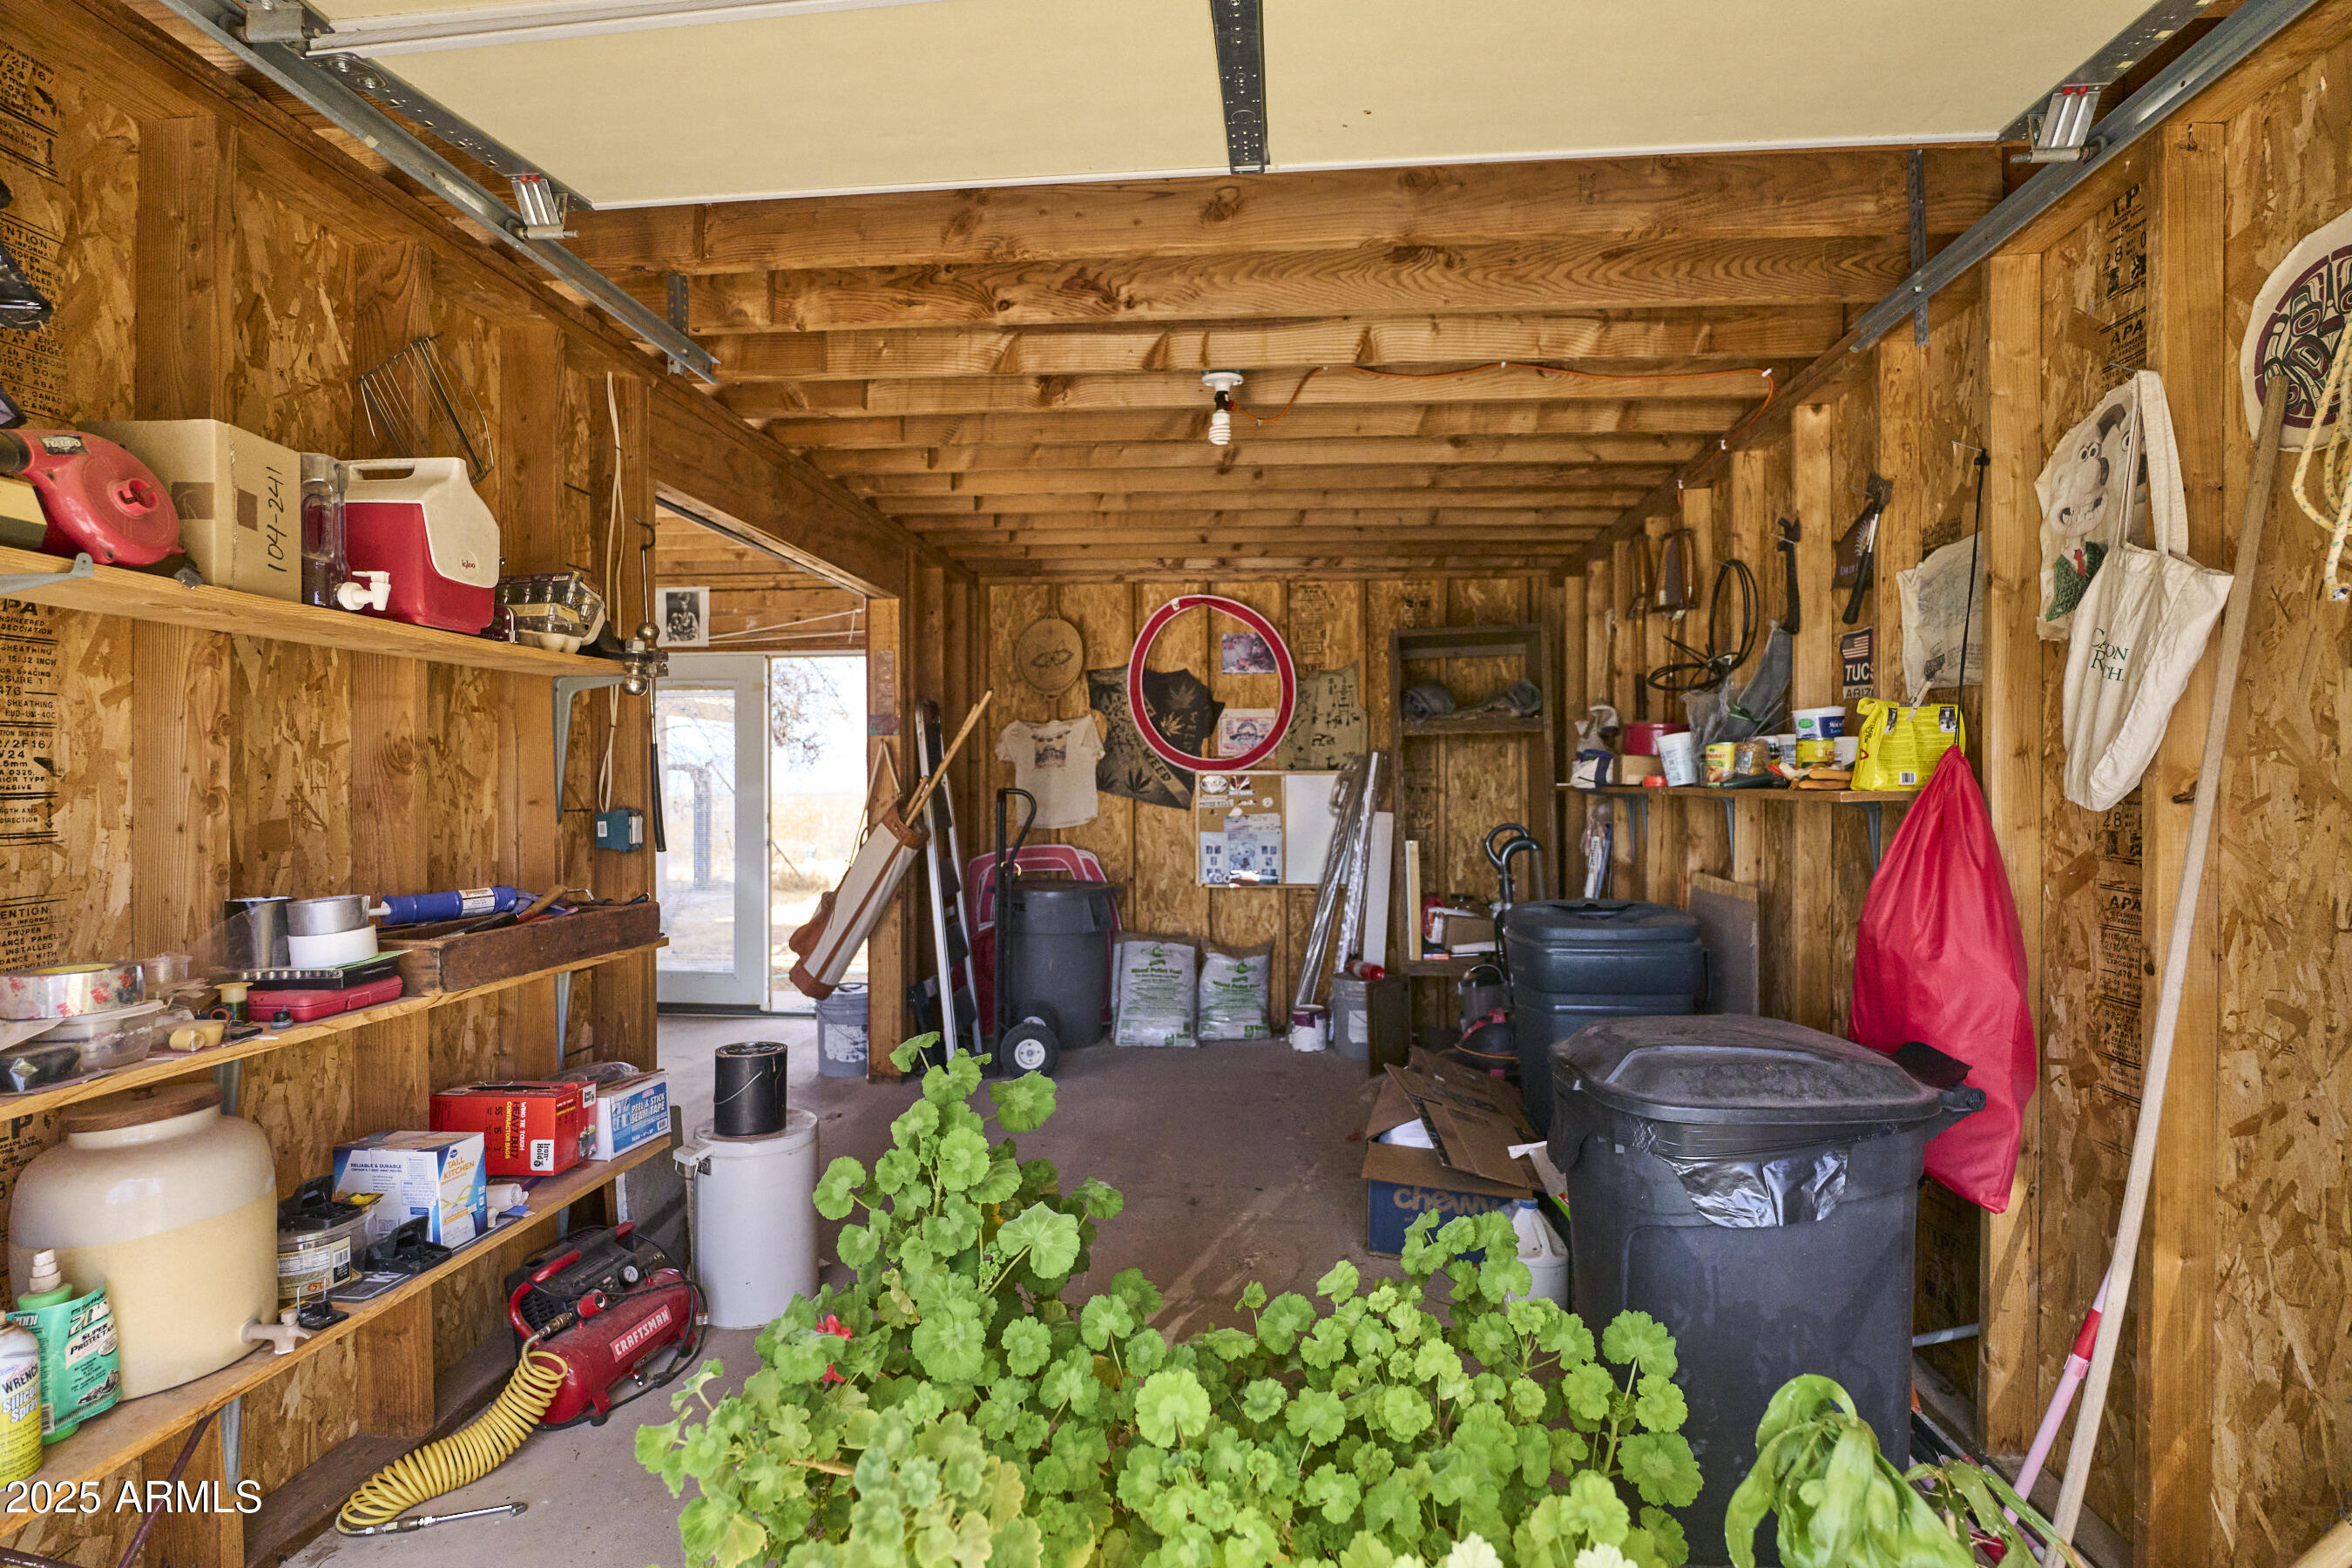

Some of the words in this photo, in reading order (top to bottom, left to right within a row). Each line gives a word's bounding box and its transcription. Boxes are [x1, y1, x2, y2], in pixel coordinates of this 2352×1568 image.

[2111, 319, 2143, 347] APA
[266, 466, 287, 572] 104-241
[461, 559, 476, 570] igloo
[1, 645, 52, 656] SHEATHING
[2091, 627, 2129, 661] CAON
[37, 658, 57, 666] INCH
[2091, 649, 2125, 682] RCH.
[7, 699, 53, 709] SHEATHING
[2110, 896, 2142, 912] APA
[5, 943, 53, 956] INSTALLED
[36, 950, 57, 960] WITH
[631, 1108, 649, 1125] SEAM
[650, 1101, 666, 1116] TAPE
[632, 1101, 644, 1114] PEEL
[645, 1099, 650, 1108] &
[650, 1092, 666, 1105] STICK
[512, 1101, 521, 1133] HEAVY
[510, 1135, 519, 1159] DUTY
[443, 1159, 476, 1179] KITCHEN
[447, 1156, 464, 1169] TALL
[70, 1324, 114, 1356] PROTECTA
[82, 1322, 108, 1342] SUPER
[614, 1309, 670, 1356] CRAFTSMAN
[3, 1382, 40, 1415] Silicon
